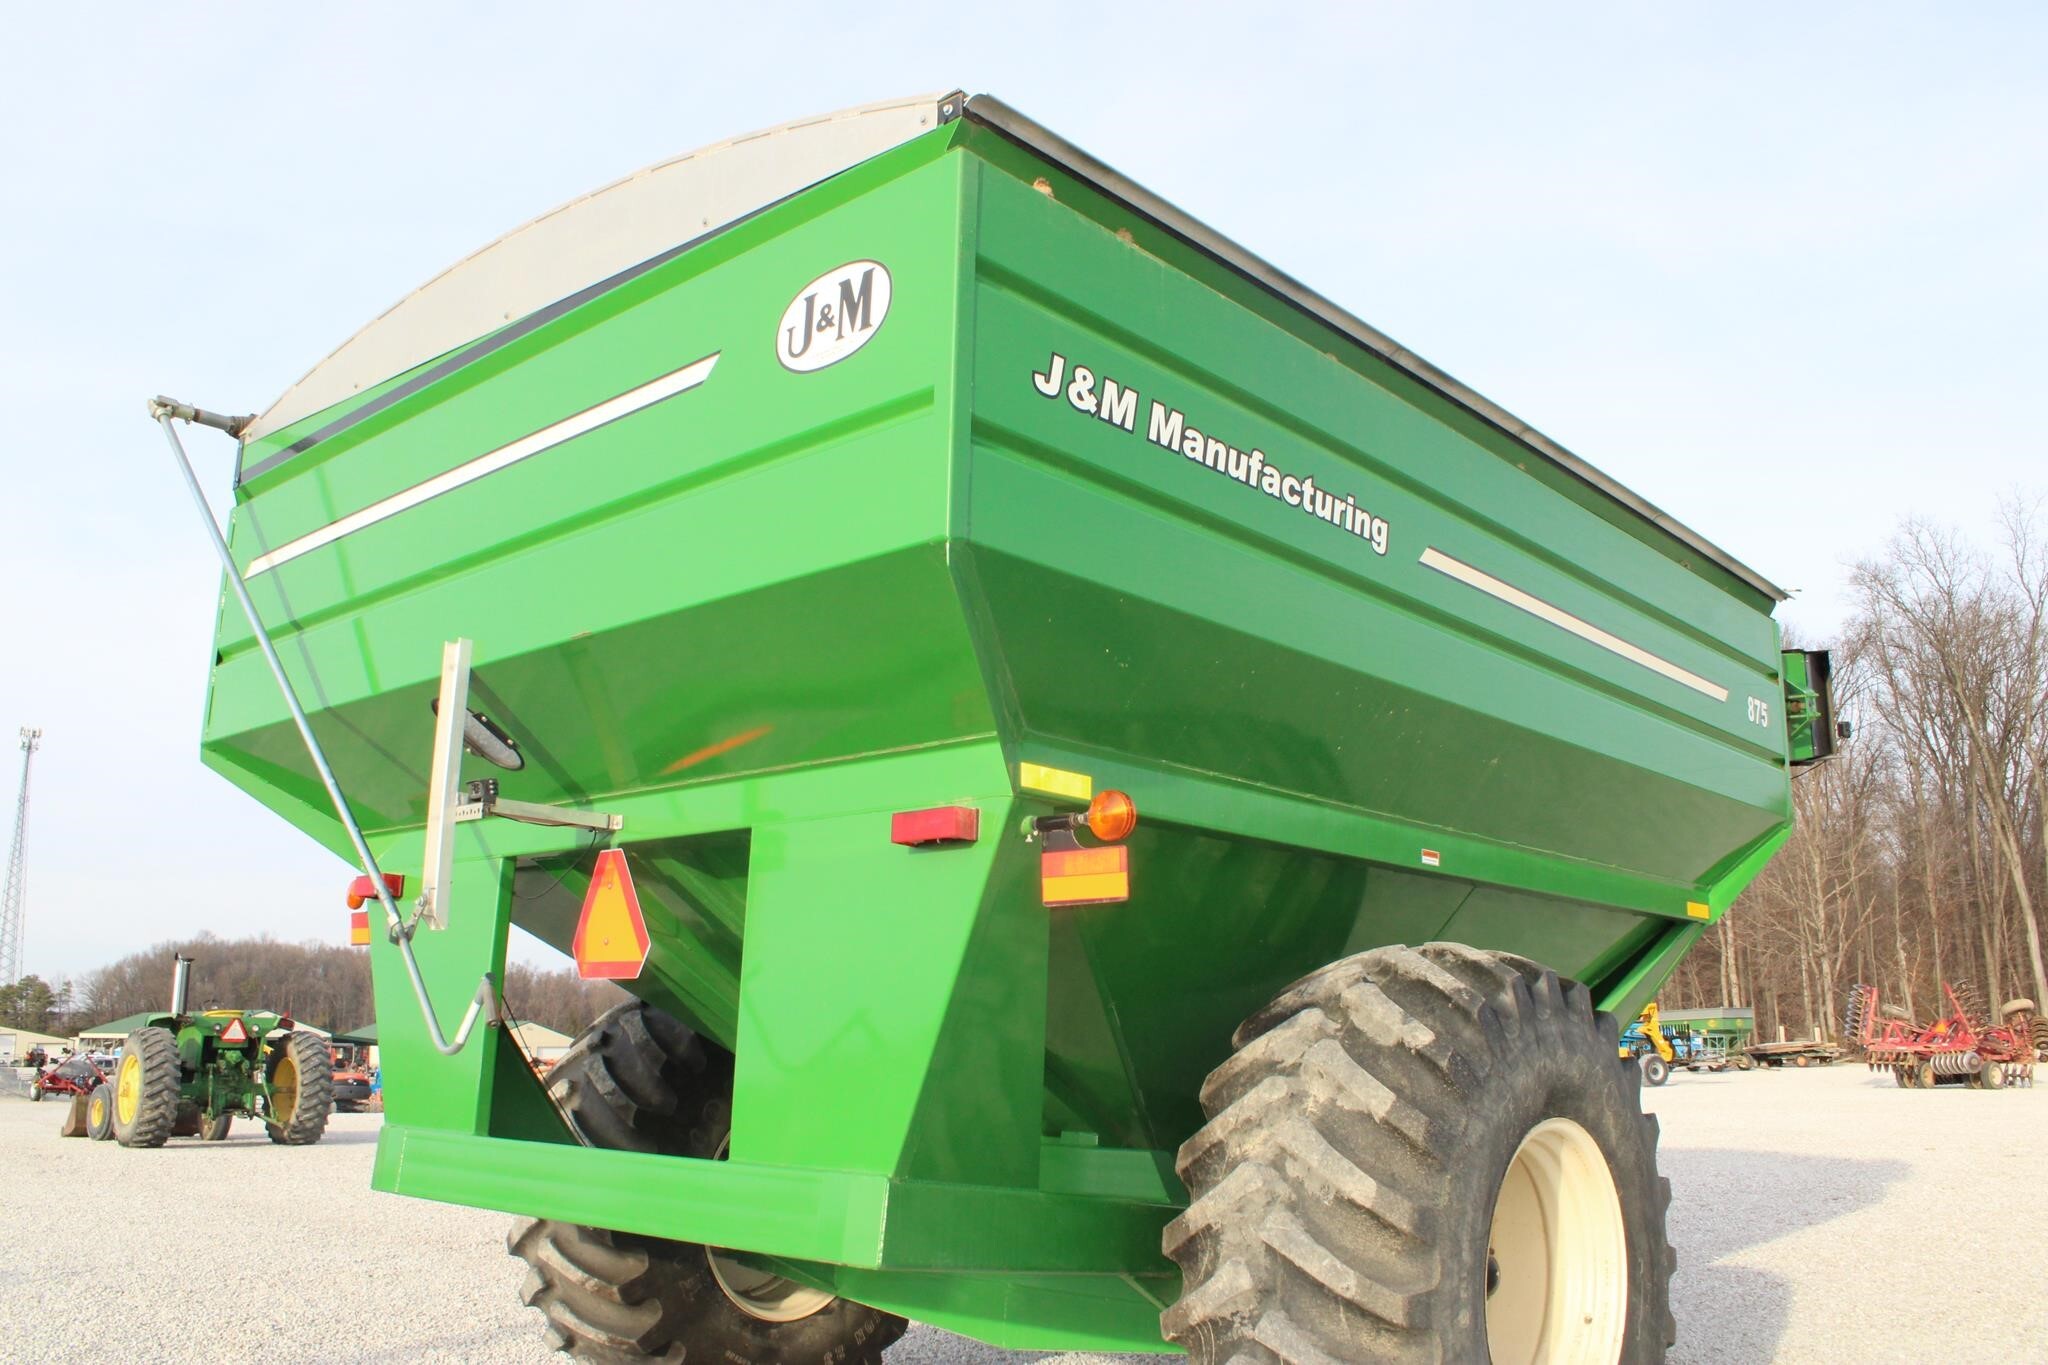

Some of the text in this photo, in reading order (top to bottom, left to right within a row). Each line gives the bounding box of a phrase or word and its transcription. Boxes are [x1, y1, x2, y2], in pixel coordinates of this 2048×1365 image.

[787, 267, 876, 359] J&M
[1032, 352, 1390, 556] J&M Manufacturing
[1747, 695, 1768, 728] 875
